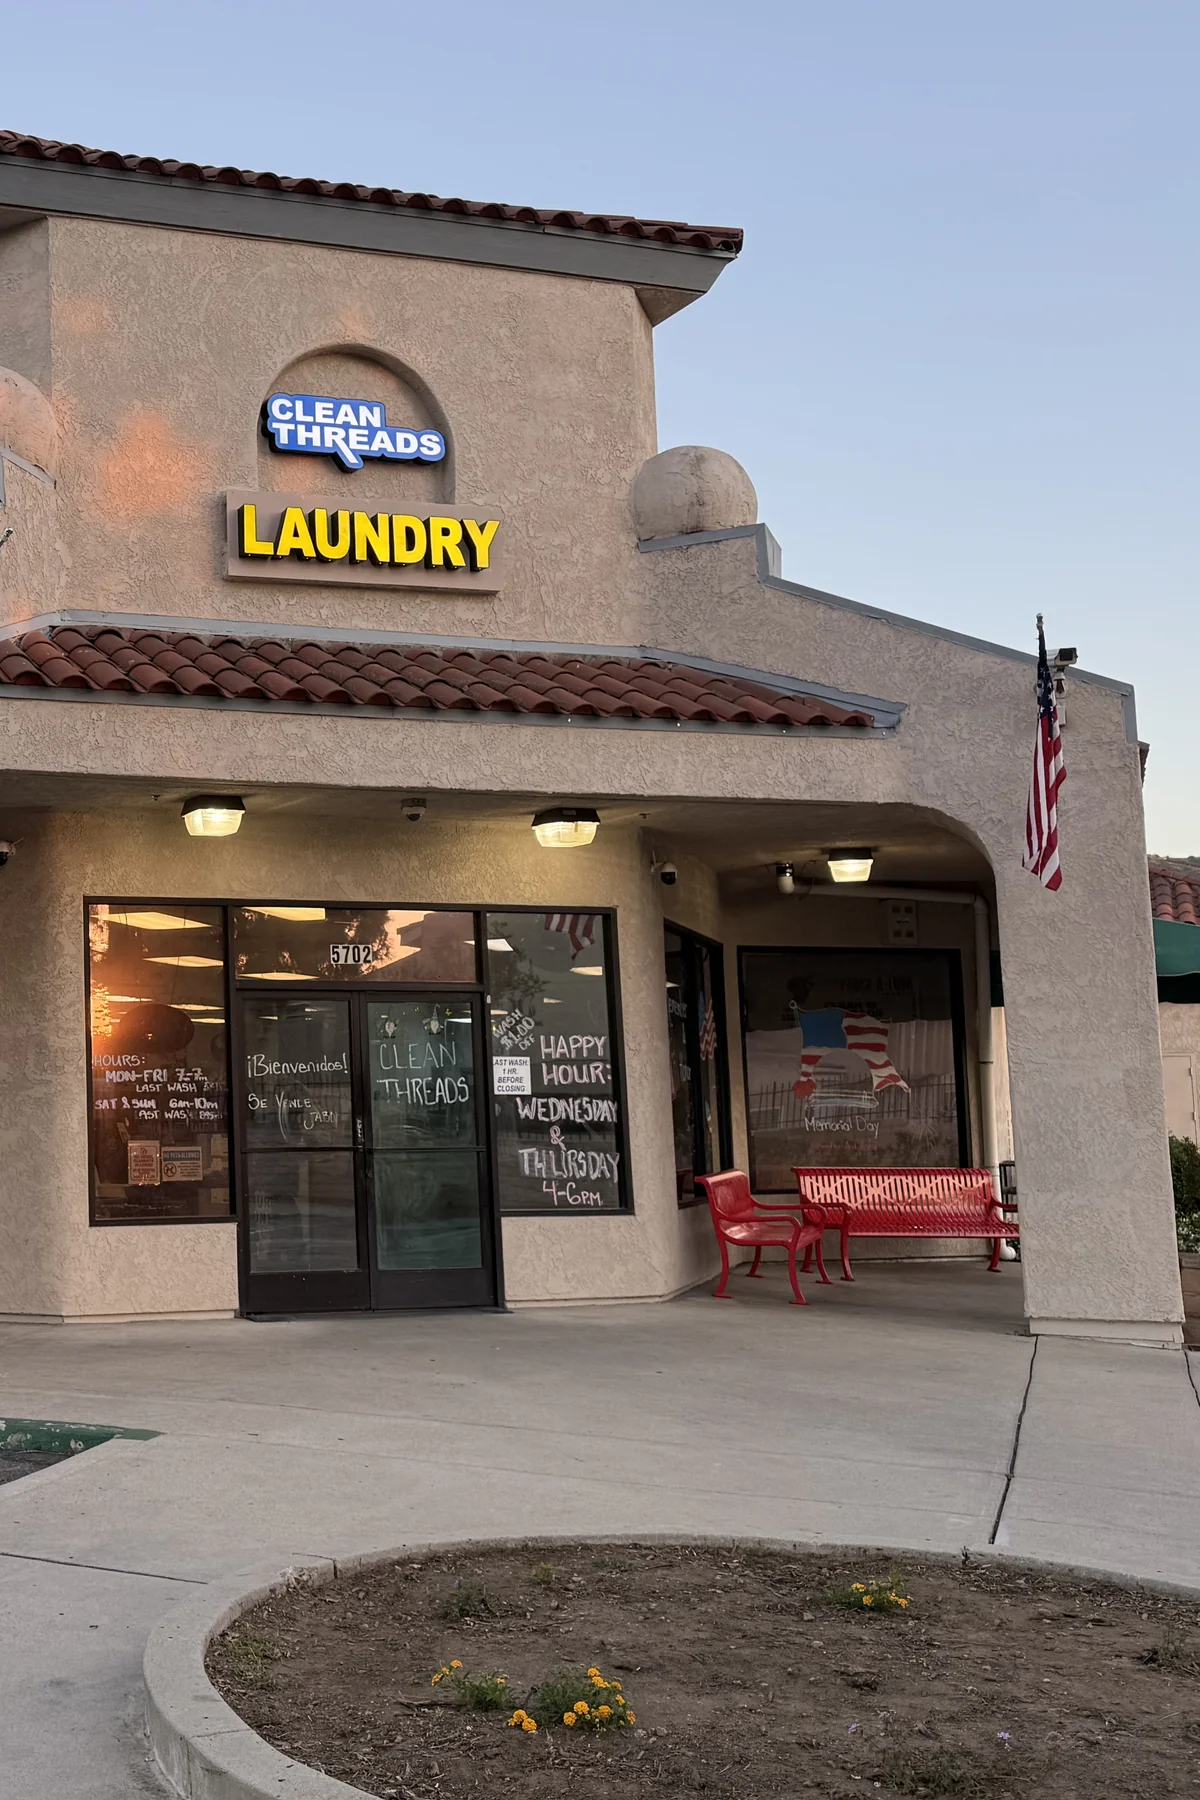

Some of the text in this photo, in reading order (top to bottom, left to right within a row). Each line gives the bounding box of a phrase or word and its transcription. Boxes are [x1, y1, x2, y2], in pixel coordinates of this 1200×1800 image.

[271, 397, 381, 428] CLEAN
[271, 422, 442, 464] THREADS
[241, 503, 500, 570] LAUNDRY
[331, 945, 372, 964] 5702
[492, 1008, 524, 1038] WASH
[379, 1040, 457, 1070] CLEAN
[540, 1034, 608, 1060] HAPPY
[93, 1054, 146, 1067] HOURS:
[247, 1053, 348, 1078] ¡Bienvenidos!
[105, 1069, 167, 1083] MON-FRI
[497, 1076, 524, 1084] BEFORE
[542, 1062, 612, 1086] HOUR:
[136, 1083, 162, 1093] LAST
[167, 1081, 197, 1093] WASH
[376, 1076, 470, 1106] THREADS
[496, 1085, 526, 1093] CLOSING
[95, 1098, 117, 1110] SAT
[122, 1096, 131, 1109] &
[132, 1098, 157, 1109] SUN
[515, 1096, 618, 1123] WEDNESDAY
[549, 1125, 567, 1151] &
[804, 1115, 880, 1139] Memorial Day
[518, 1148, 620, 1183] THURSDAY
